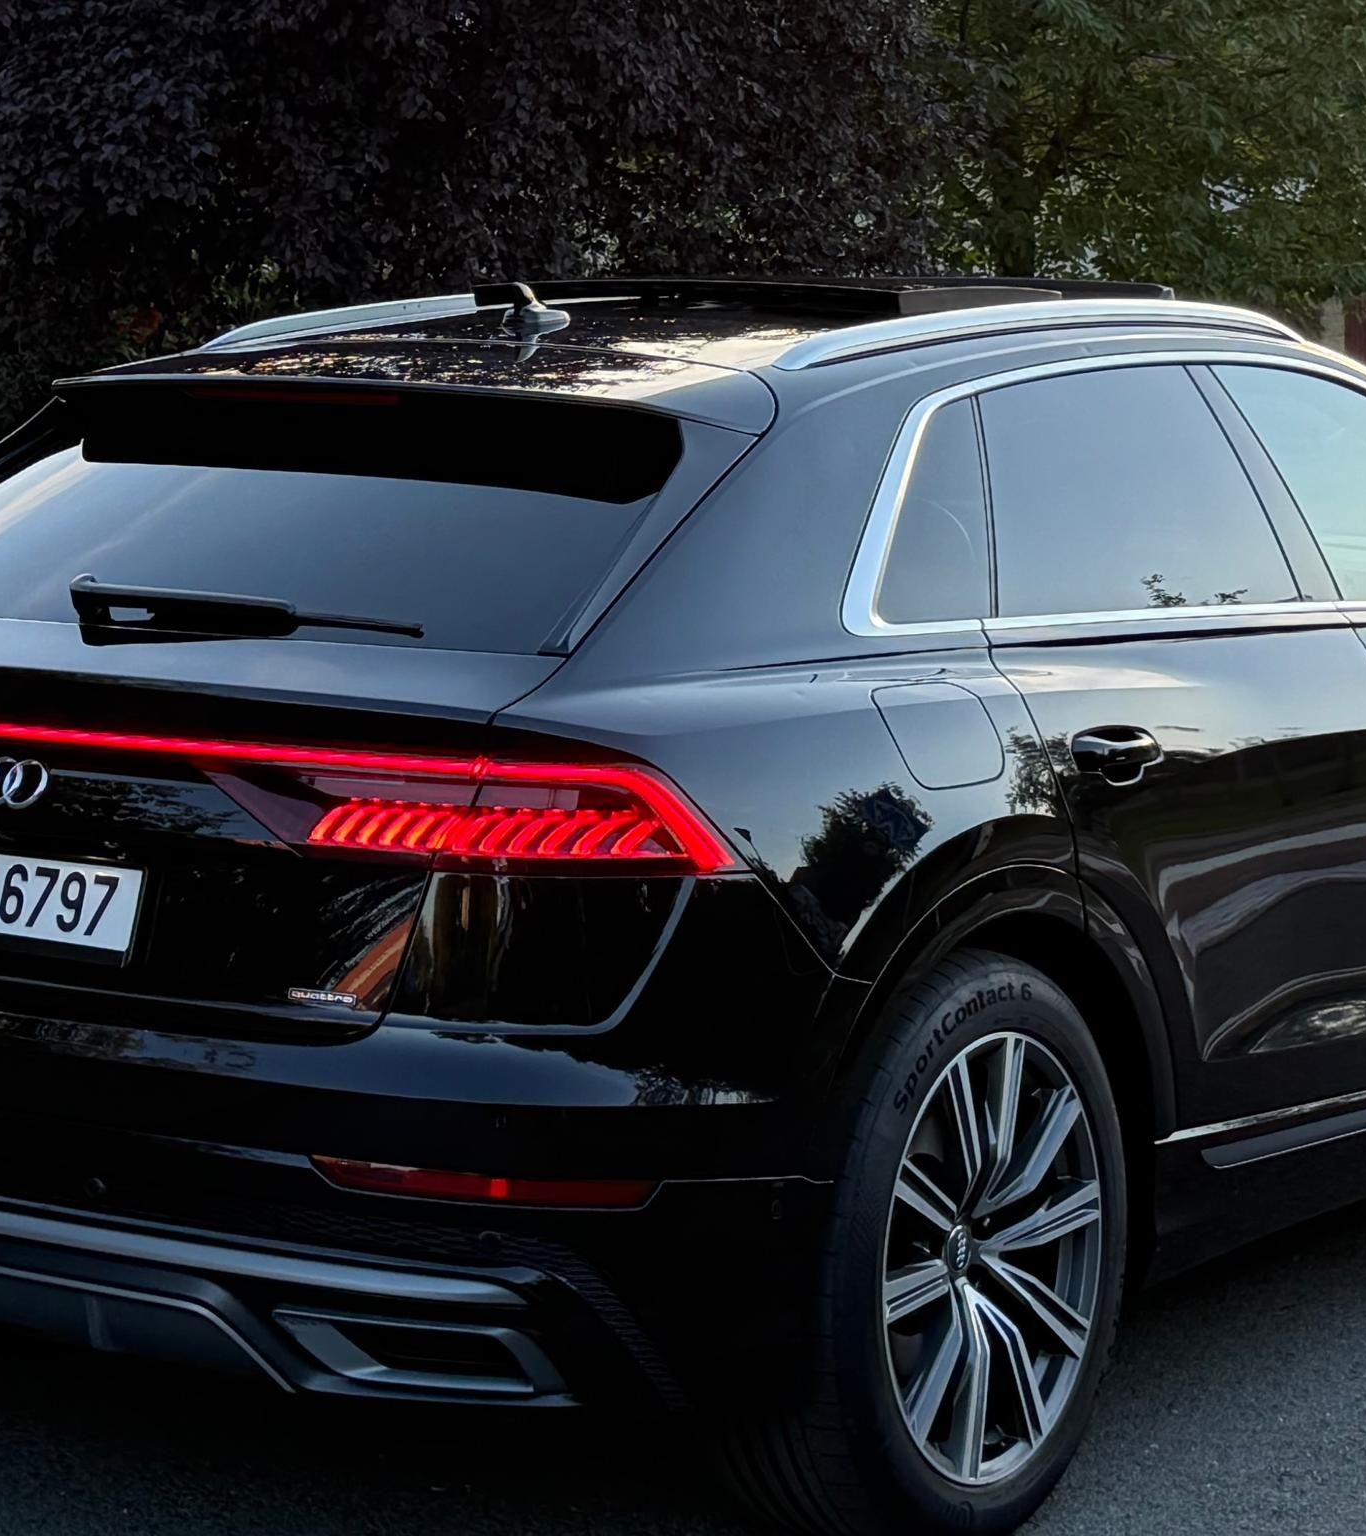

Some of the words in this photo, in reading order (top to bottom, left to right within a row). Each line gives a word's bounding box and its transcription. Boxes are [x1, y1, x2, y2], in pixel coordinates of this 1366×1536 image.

[0, 864, 120, 936] 6797
[291, 990, 353, 1004] quattro
[893, 982, 1015, 1115] SportContact
[1020, 982, 1033, 1002] 6
